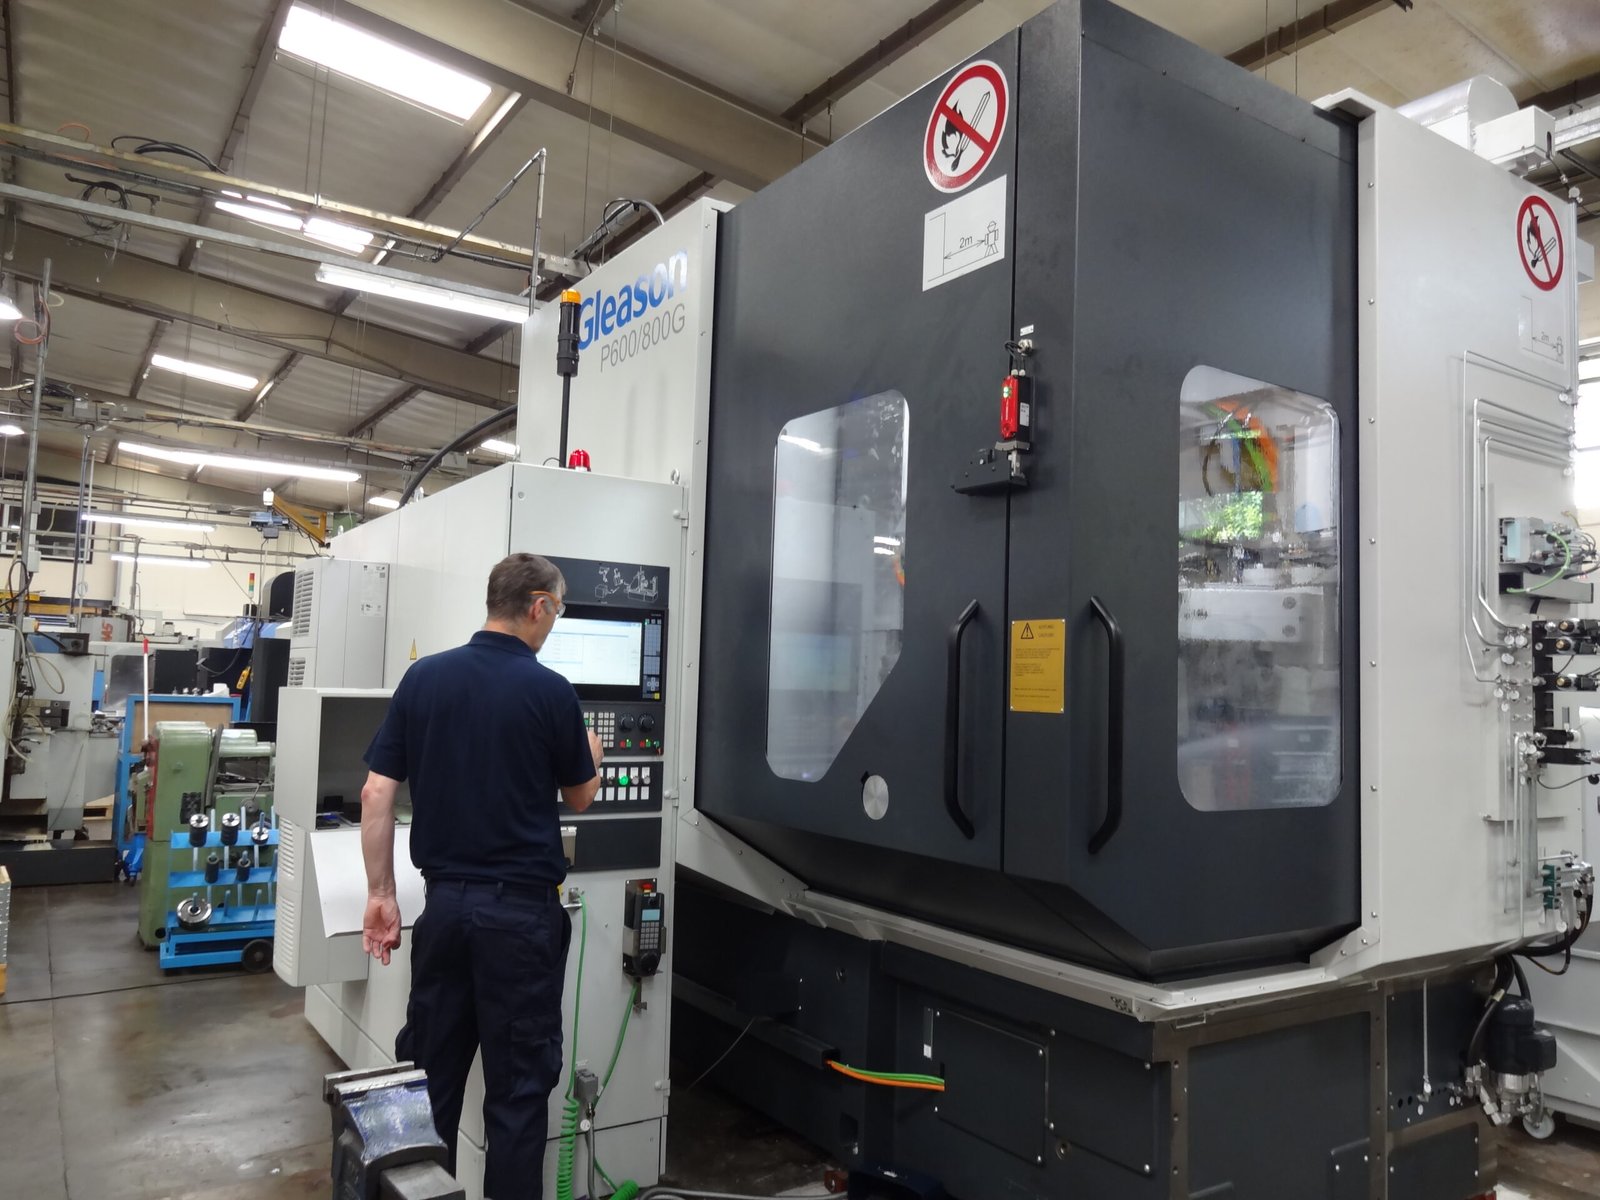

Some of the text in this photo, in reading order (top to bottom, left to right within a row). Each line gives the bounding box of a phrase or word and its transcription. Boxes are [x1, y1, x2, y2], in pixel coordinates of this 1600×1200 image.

[959, 236, 973, 249] 2m
[577, 249, 688, 351] Gleason
[600, 303, 686, 373] P600/800G
